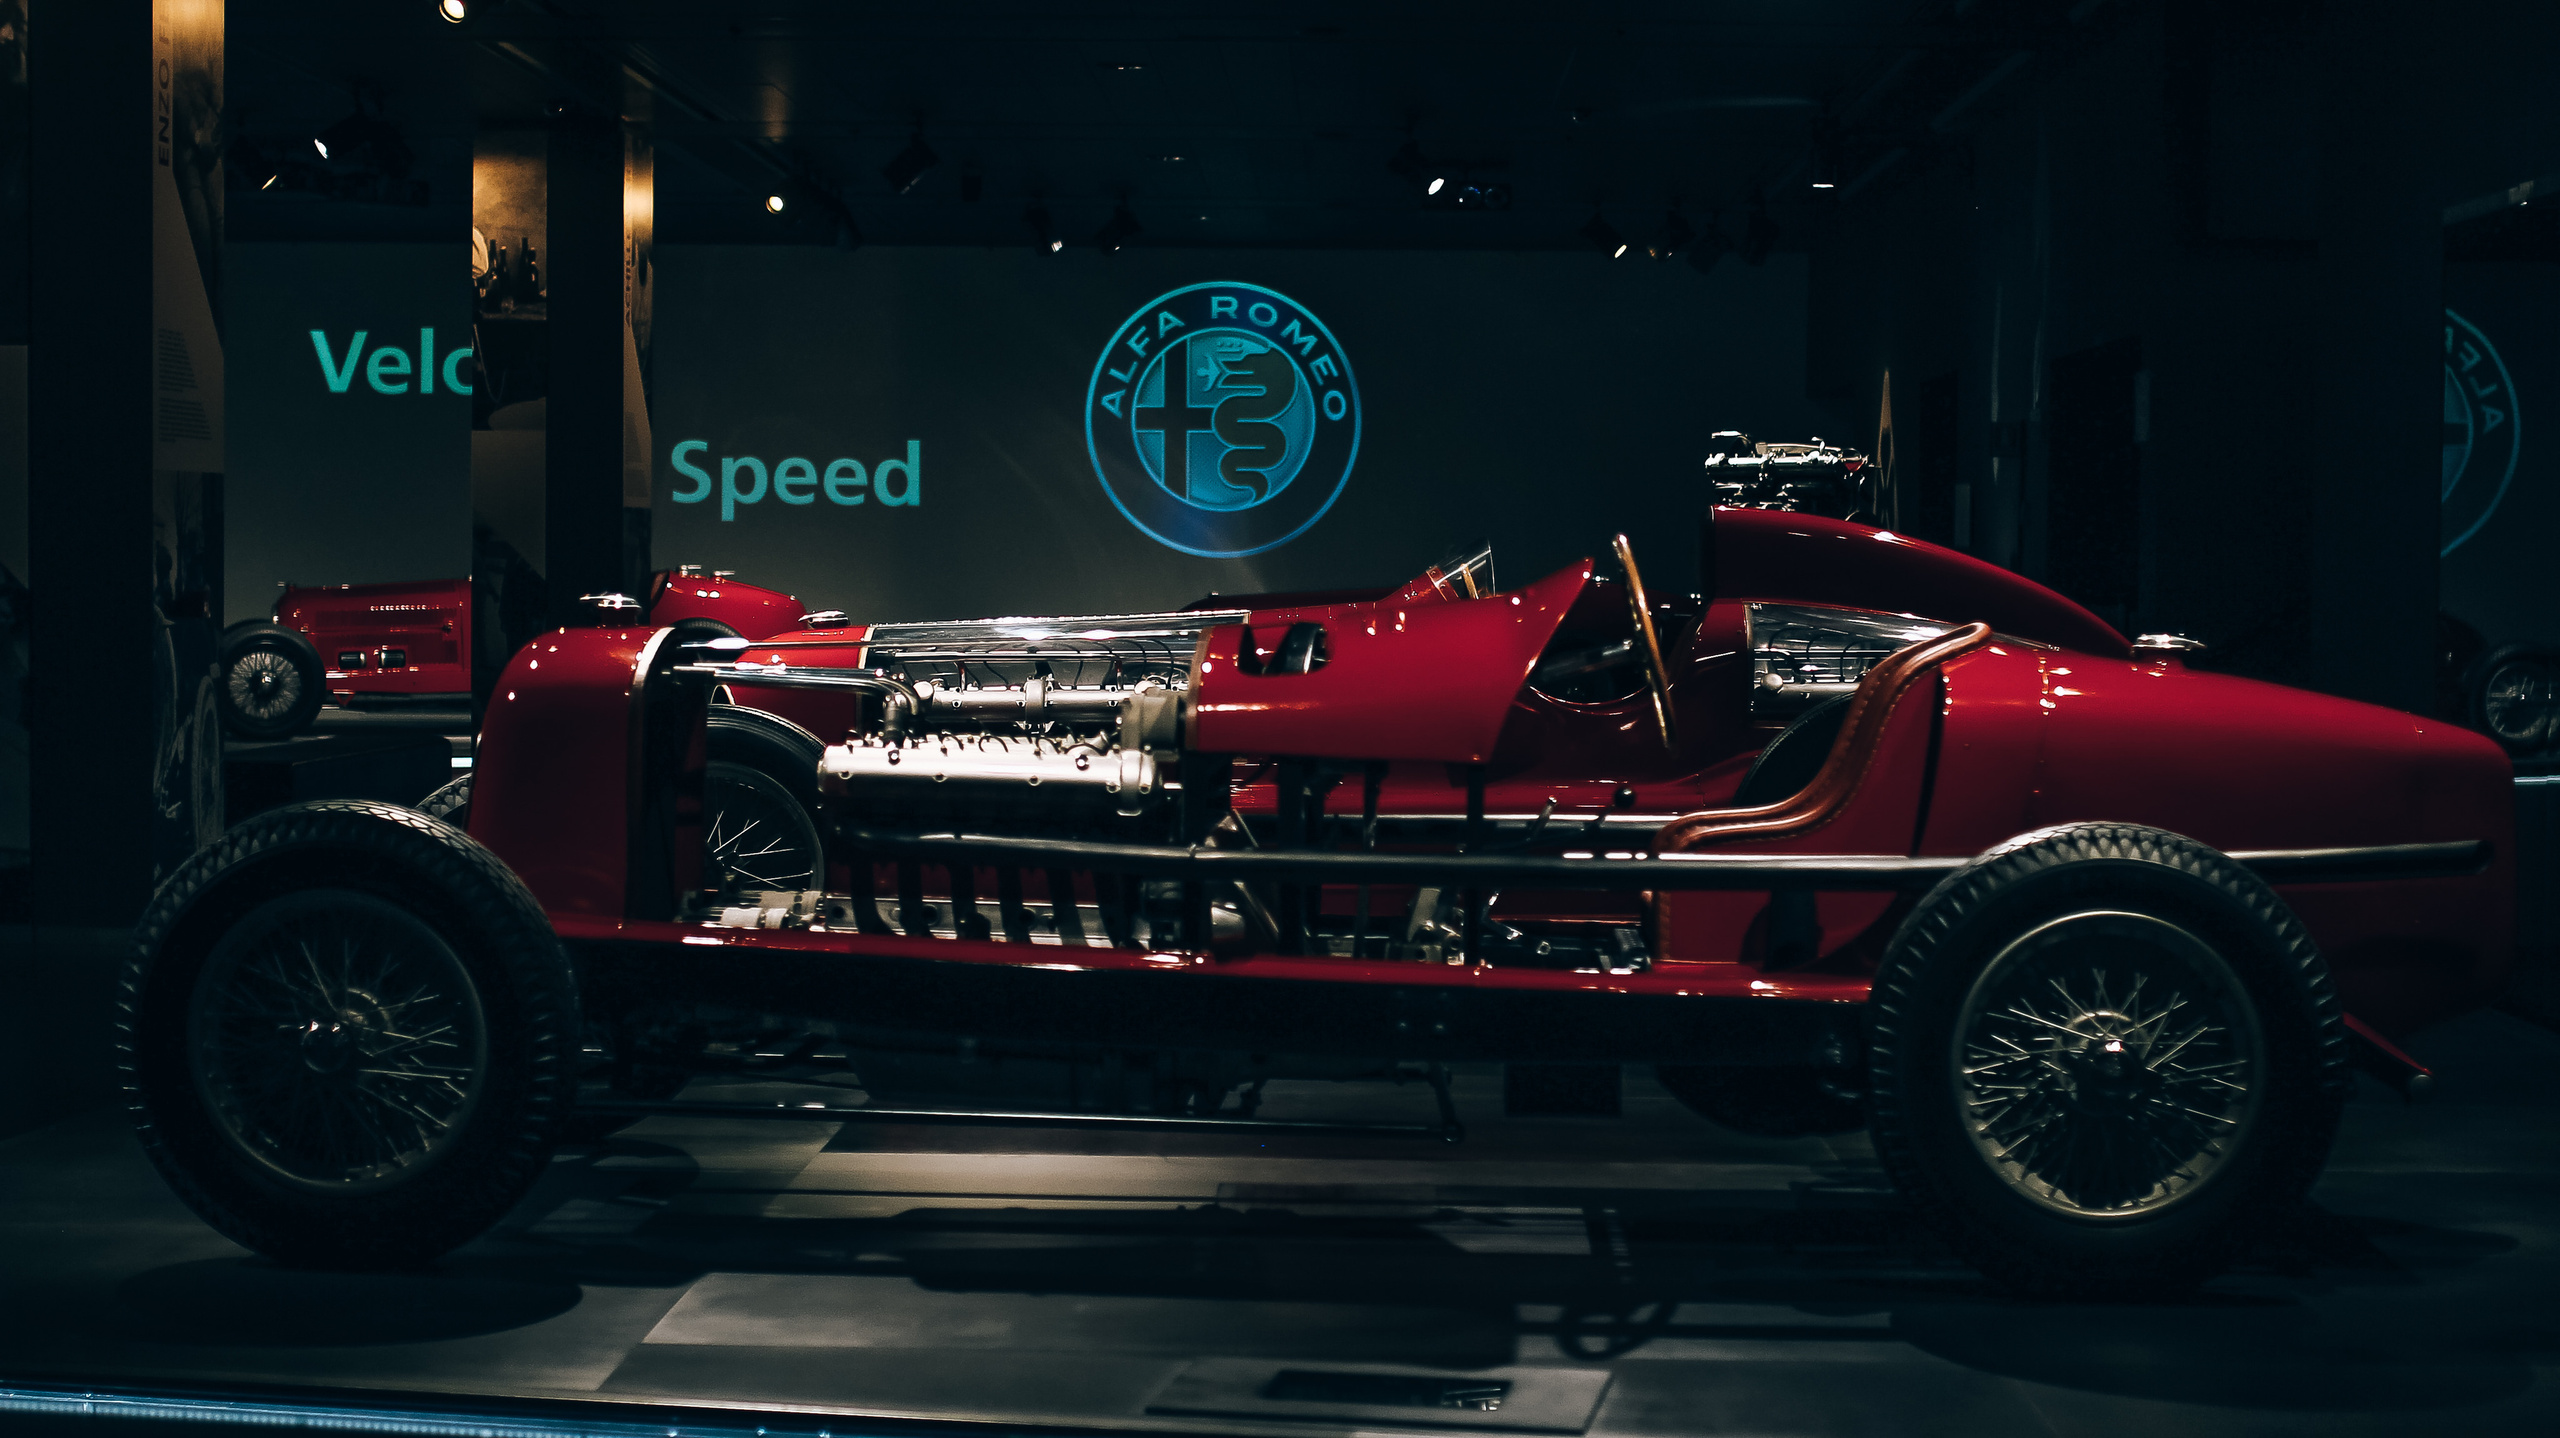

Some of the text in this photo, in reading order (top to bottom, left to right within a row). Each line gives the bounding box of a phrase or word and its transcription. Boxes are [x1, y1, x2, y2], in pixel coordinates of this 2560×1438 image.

[158, 58, 169, 167] ENZO
[1100, 295, 1347, 421] ALFA ROMEO
[671, 439, 921, 522] Speed
